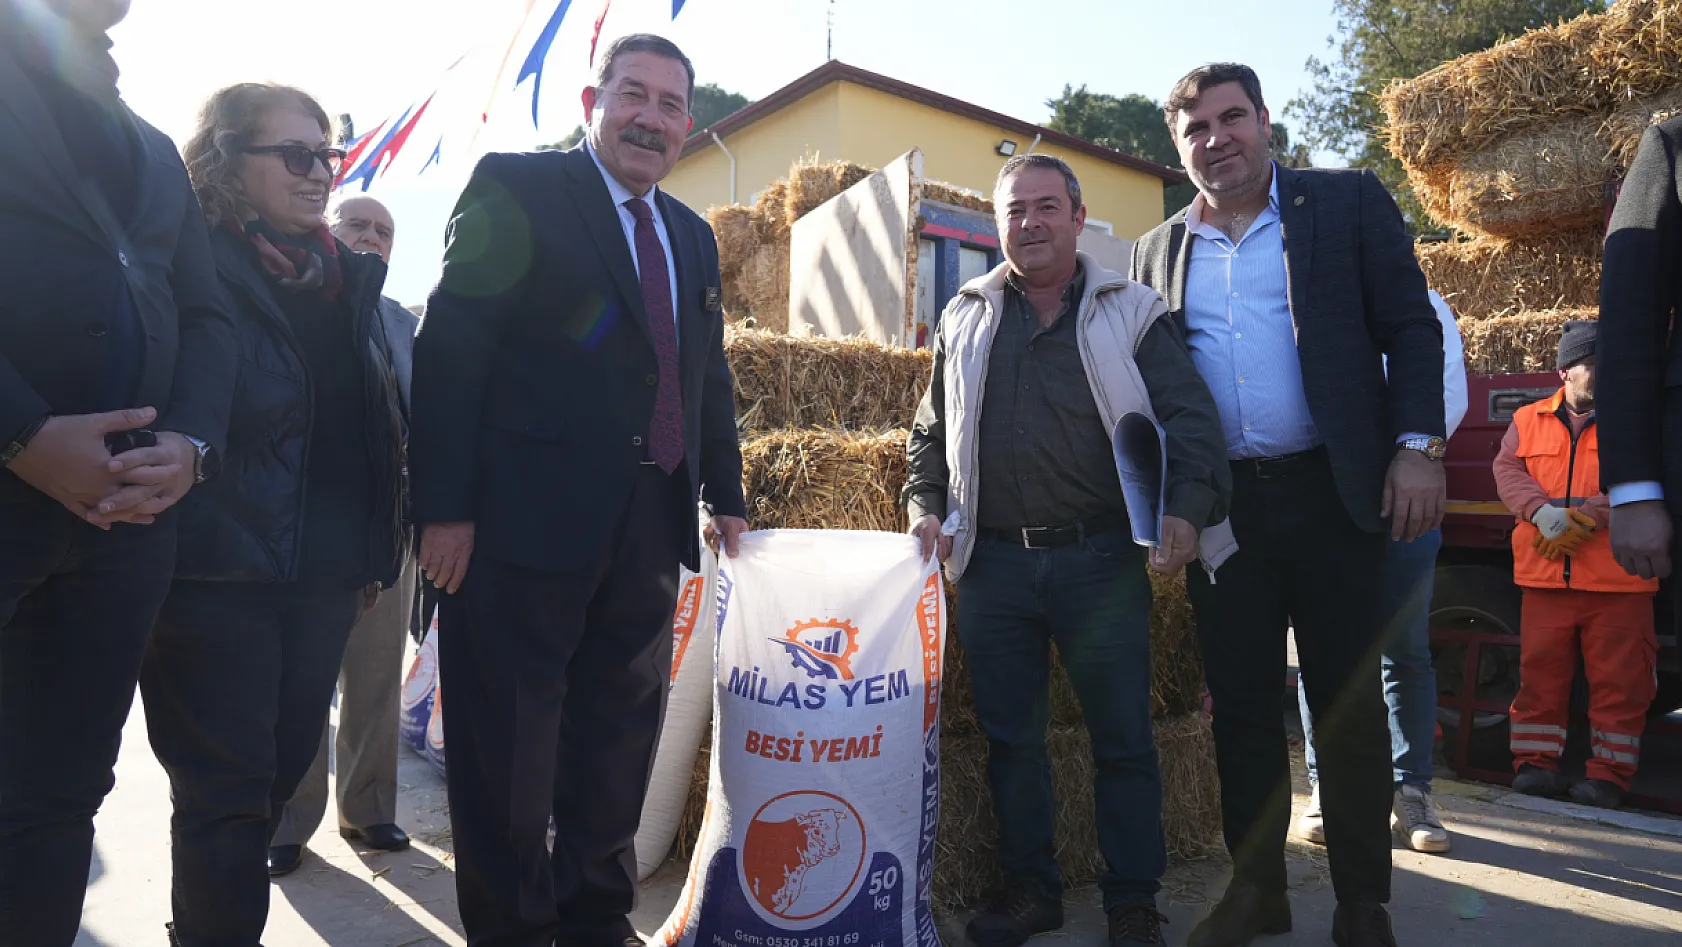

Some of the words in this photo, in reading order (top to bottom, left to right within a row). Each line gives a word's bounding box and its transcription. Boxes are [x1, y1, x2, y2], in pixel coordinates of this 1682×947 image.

[728, 666, 827, 710] MİLAS
[839, 669, 910, 708] YEM
[745, 729, 804, 763] BESİ
[809, 724, 884, 763] YEMİ
[922, 782, 937, 855] YEM
[868, 866, 898, 895] 50
[873, 894, 891, 911] kg
[734, 929, 763, 945] Gsm:
[766, 936, 799, 947] 0530
[803, 938, 824, 947] 341
[827, 935, 841, 946] 81
[843, 932, 860, 944] 69
